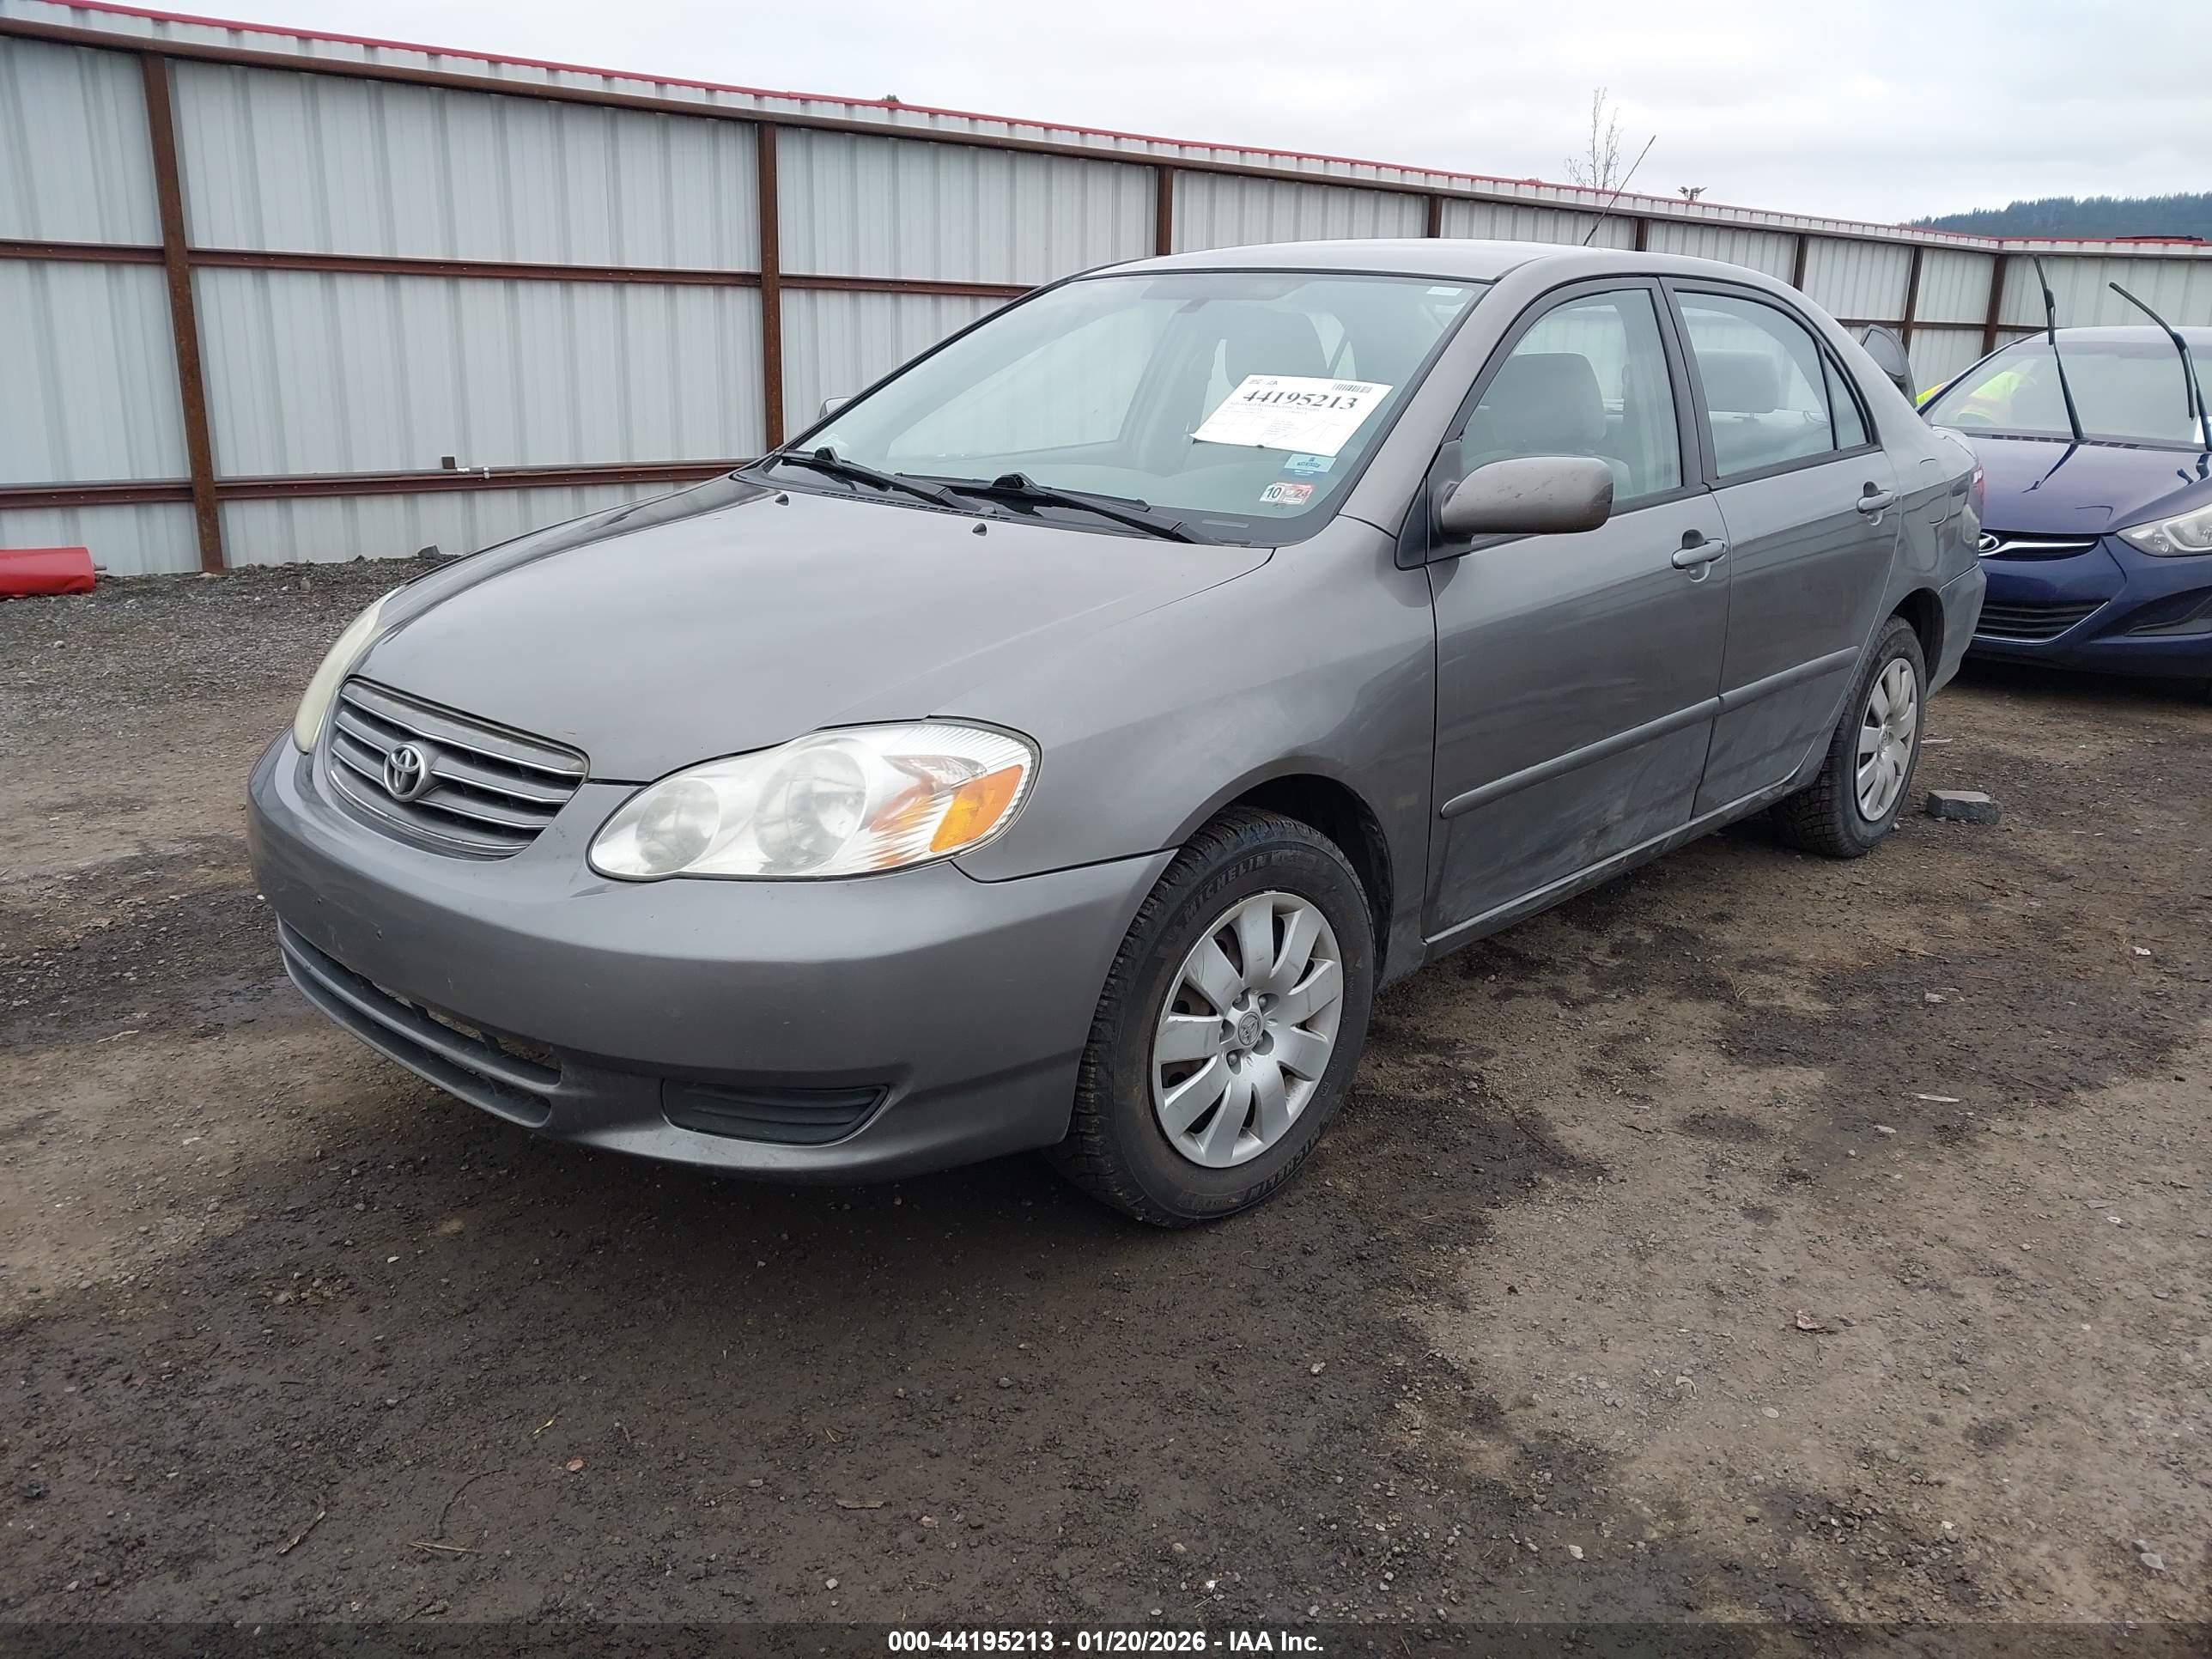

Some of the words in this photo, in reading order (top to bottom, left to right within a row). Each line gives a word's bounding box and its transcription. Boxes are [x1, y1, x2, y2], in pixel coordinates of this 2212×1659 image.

[1243, 389, 1358, 410] 44195213
[1267, 486, 1282, 499] 10
[1182, 854, 1267, 923] MICHELIN
